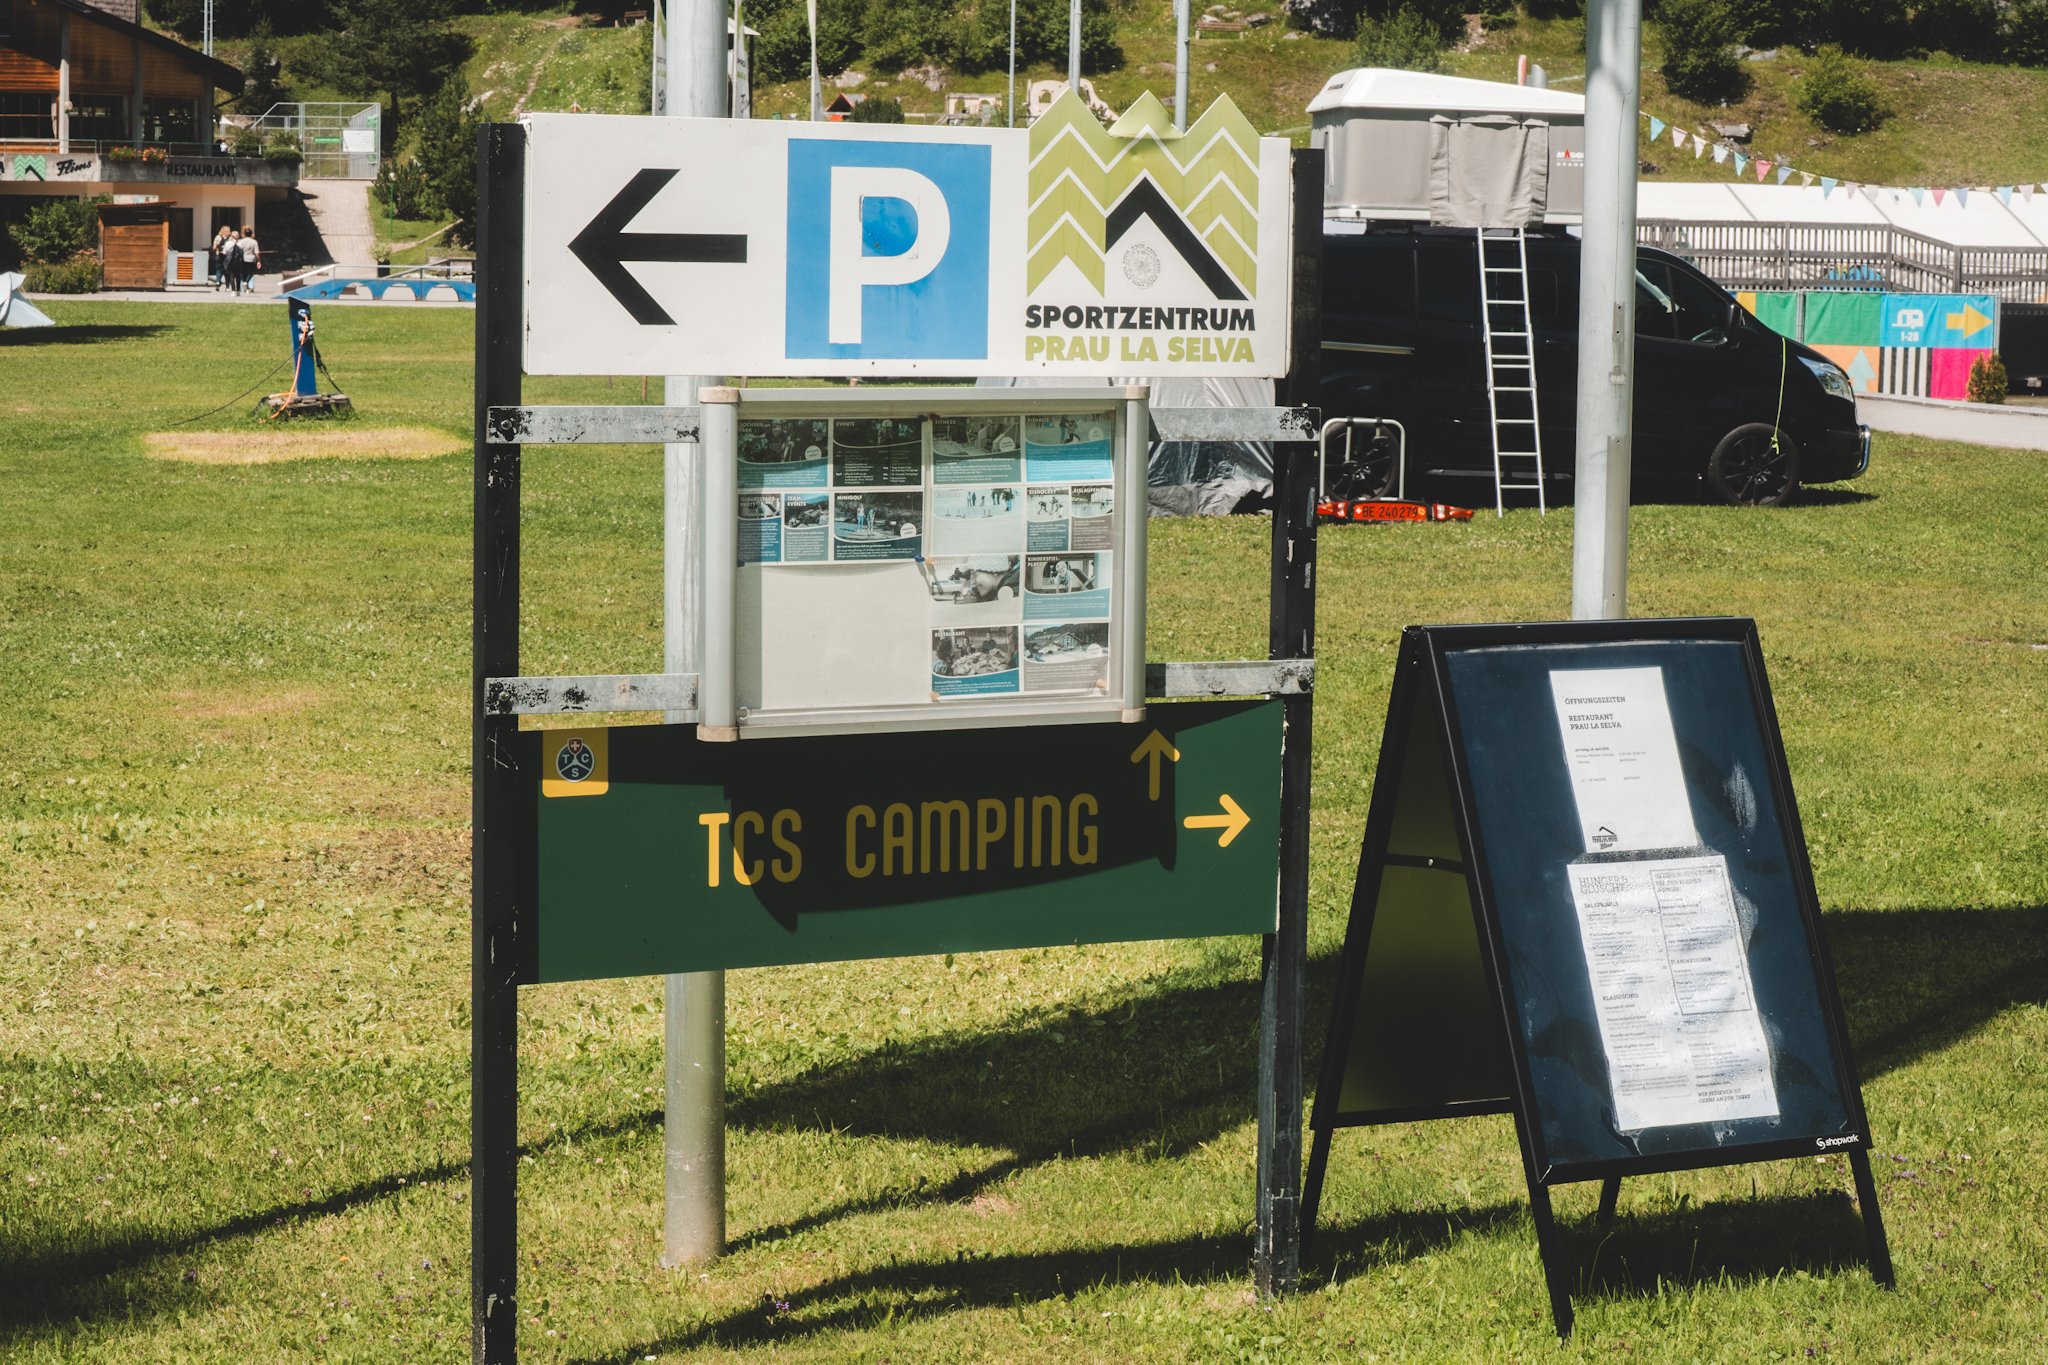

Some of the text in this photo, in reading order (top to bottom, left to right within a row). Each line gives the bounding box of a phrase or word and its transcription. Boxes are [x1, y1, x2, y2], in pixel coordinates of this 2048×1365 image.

[55, 158, 93, 177] Flims
[166, 164, 237, 178] RESTAURANT
[829, 165, 951, 344] P
[1025, 304, 1256, 331] SPORTZENTRUM
[1900, 331, 1919, 342] 1-28
[1025, 335, 1256, 363] PRAU LA SELVA
[1362, 505, 1419, 518] BE 240279
[1564, 696, 1626, 705] ÖFFNUNGSZEITEN
[1568, 713, 1613, 722] RESTAURANT
[698, 808, 802, 888] TCS
[1578, 876, 1620, 886] HUNGER
[1825, 1133, 1859, 1147] shopwork
